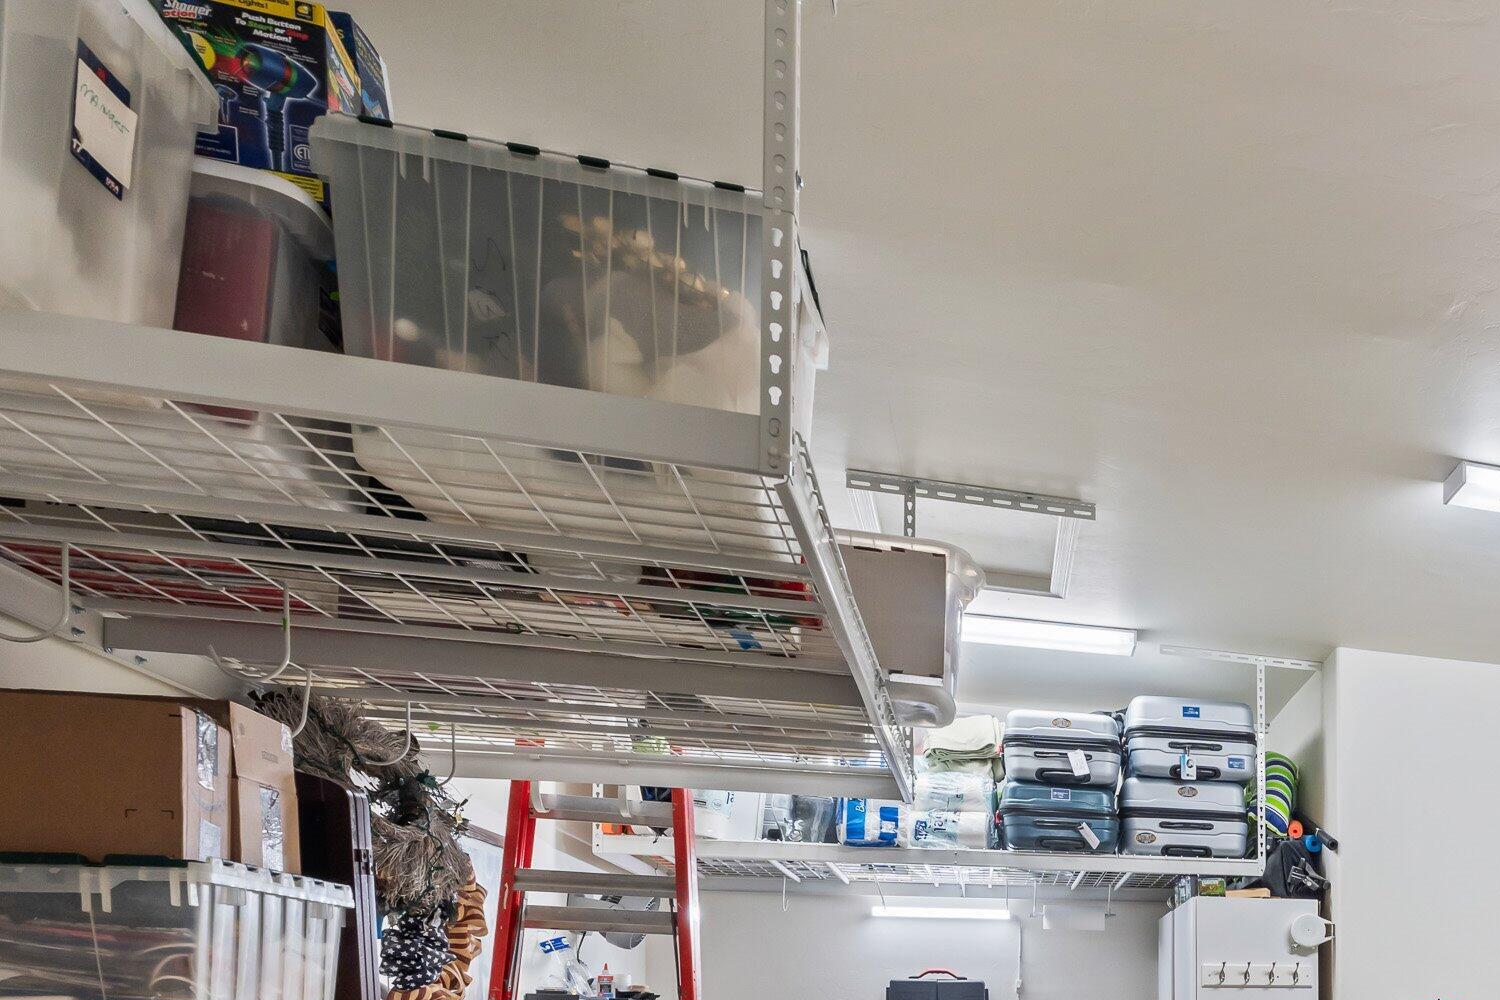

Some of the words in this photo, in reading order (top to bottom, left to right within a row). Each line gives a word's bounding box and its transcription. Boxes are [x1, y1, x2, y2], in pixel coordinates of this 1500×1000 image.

[163, 9, 197, 19] otion
[241, 12, 266, 24] Push
[267, 17, 301, 31] Button
[235, 17, 247, 26] To
[274, 27, 285, 35] or
[253, 29, 292, 43] Motion!
